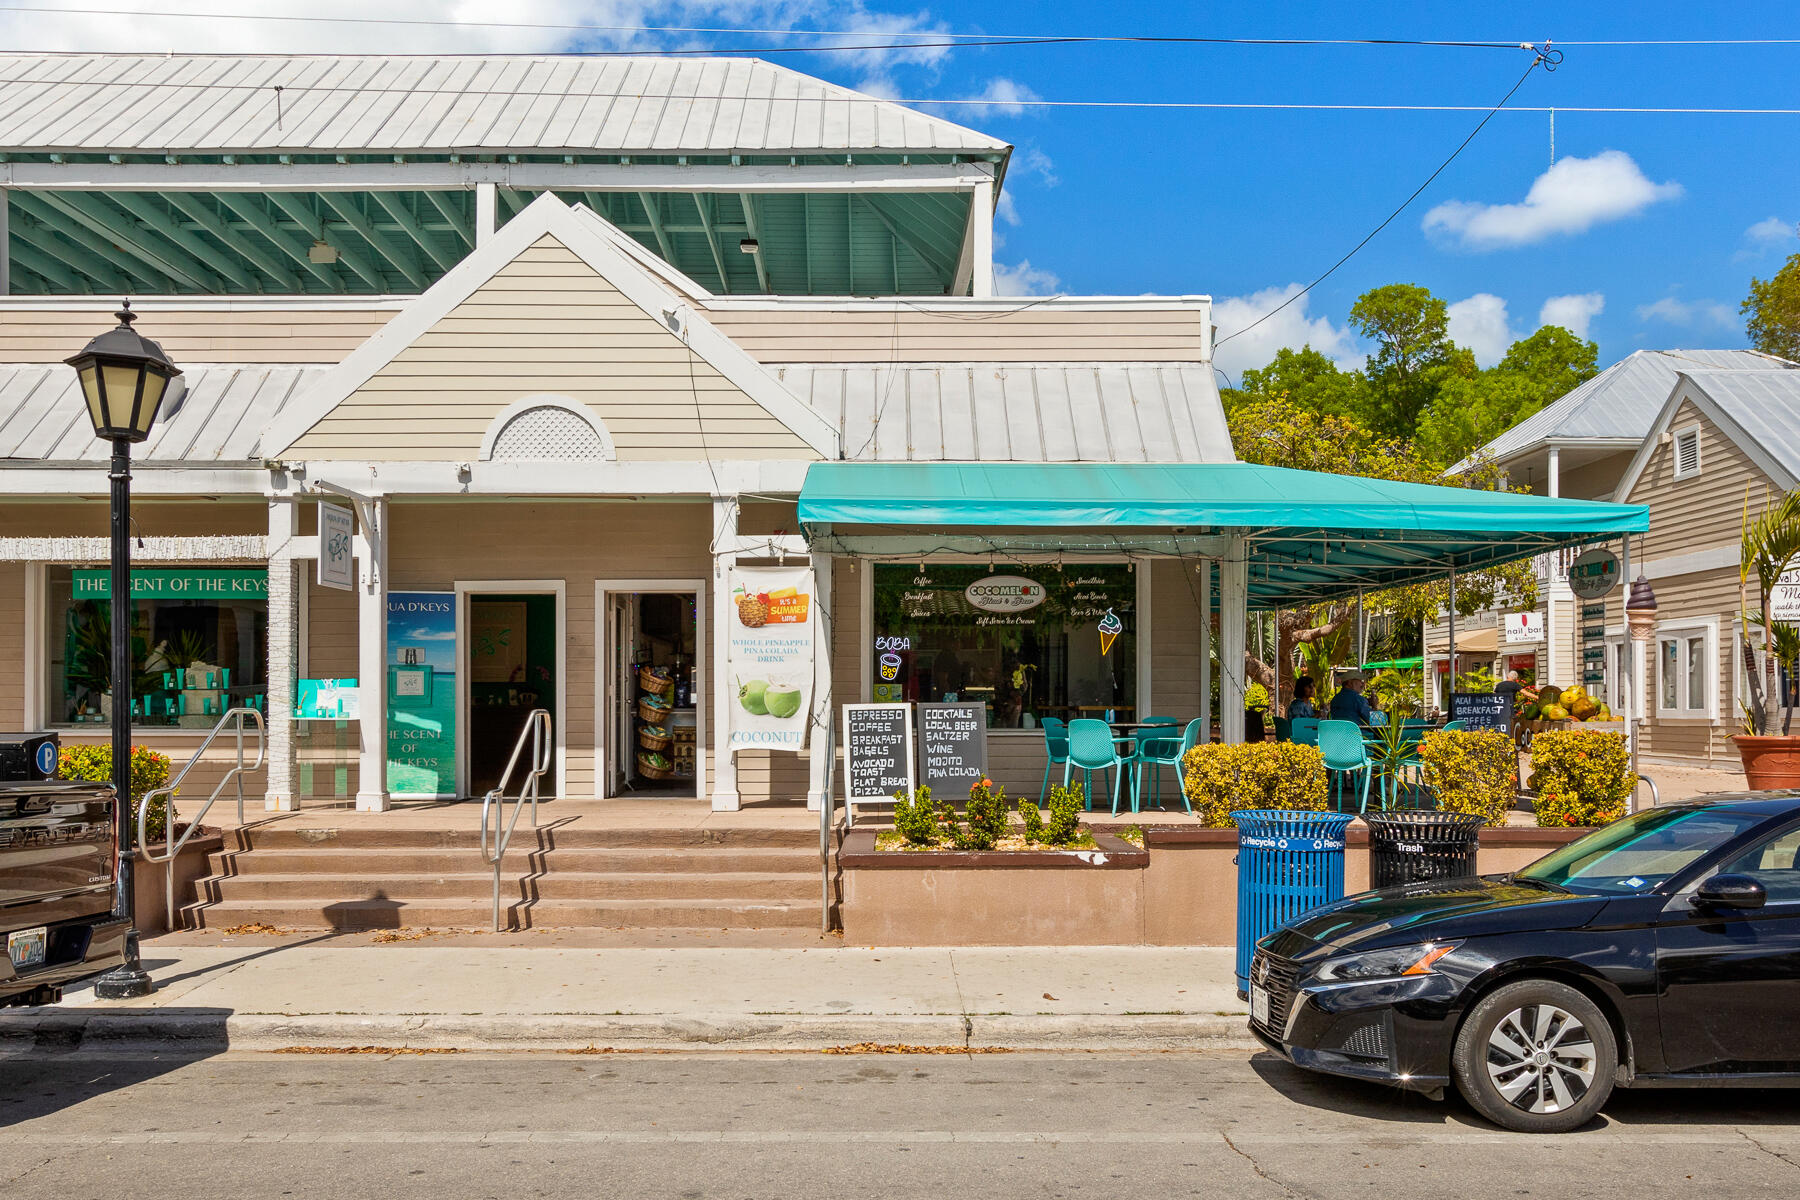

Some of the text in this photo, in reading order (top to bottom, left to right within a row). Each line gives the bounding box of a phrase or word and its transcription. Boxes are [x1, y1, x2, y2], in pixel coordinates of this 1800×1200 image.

[76, 578, 269, 592] THE CENT OF THE KEYS
[913, 576, 933, 586] Coffee
[970, 586, 1040, 596] COCOMELON
[904, 592, 934, 603] Breakfast
[387, 602, 450, 612] UA D'KEYS
[770, 605, 808, 615] SUMMER
[1016, 617, 1036, 625] Cream
[1507, 626, 1542, 635] nail bar
[876, 636, 910, 650] BOBA
[766, 647, 799, 655] COLADA
[851, 710, 903, 720] ESPRESSO
[925, 709, 973, 719] COCKTAILS
[1456, 706, 1504, 715] BREAKFAST
[925, 721, 977, 730] LOCAL BEER
[1457, 717, 1492, 725] OFFEE
[851, 722, 892, 732] COFFEE
[387, 730, 442, 740] HE SCENT
[732, 731, 802, 743] COCONUT
[852, 735, 903, 745] BREAKFAST
[926, 731, 970, 741] SALTZER
[401, 743, 418, 753] OF
[853, 745, 889, 756] BAGELS
[926, 742, 953, 753] WINE
[388, 758, 439, 767] HE KEYS
[852, 758, 895, 768] AVOCADO
[927, 756, 962, 767] MOJITO
[853, 768, 885, 777] TOAST
[928, 767, 980, 779] PINA COLADA
[853, 776, 908, 787] FLAT BREAD
[854, 786, 885, 796] PIZZA
[1247, 837, 1344, 849] Recycle Recyc
[1397, 842, 1424, 852] Trash
